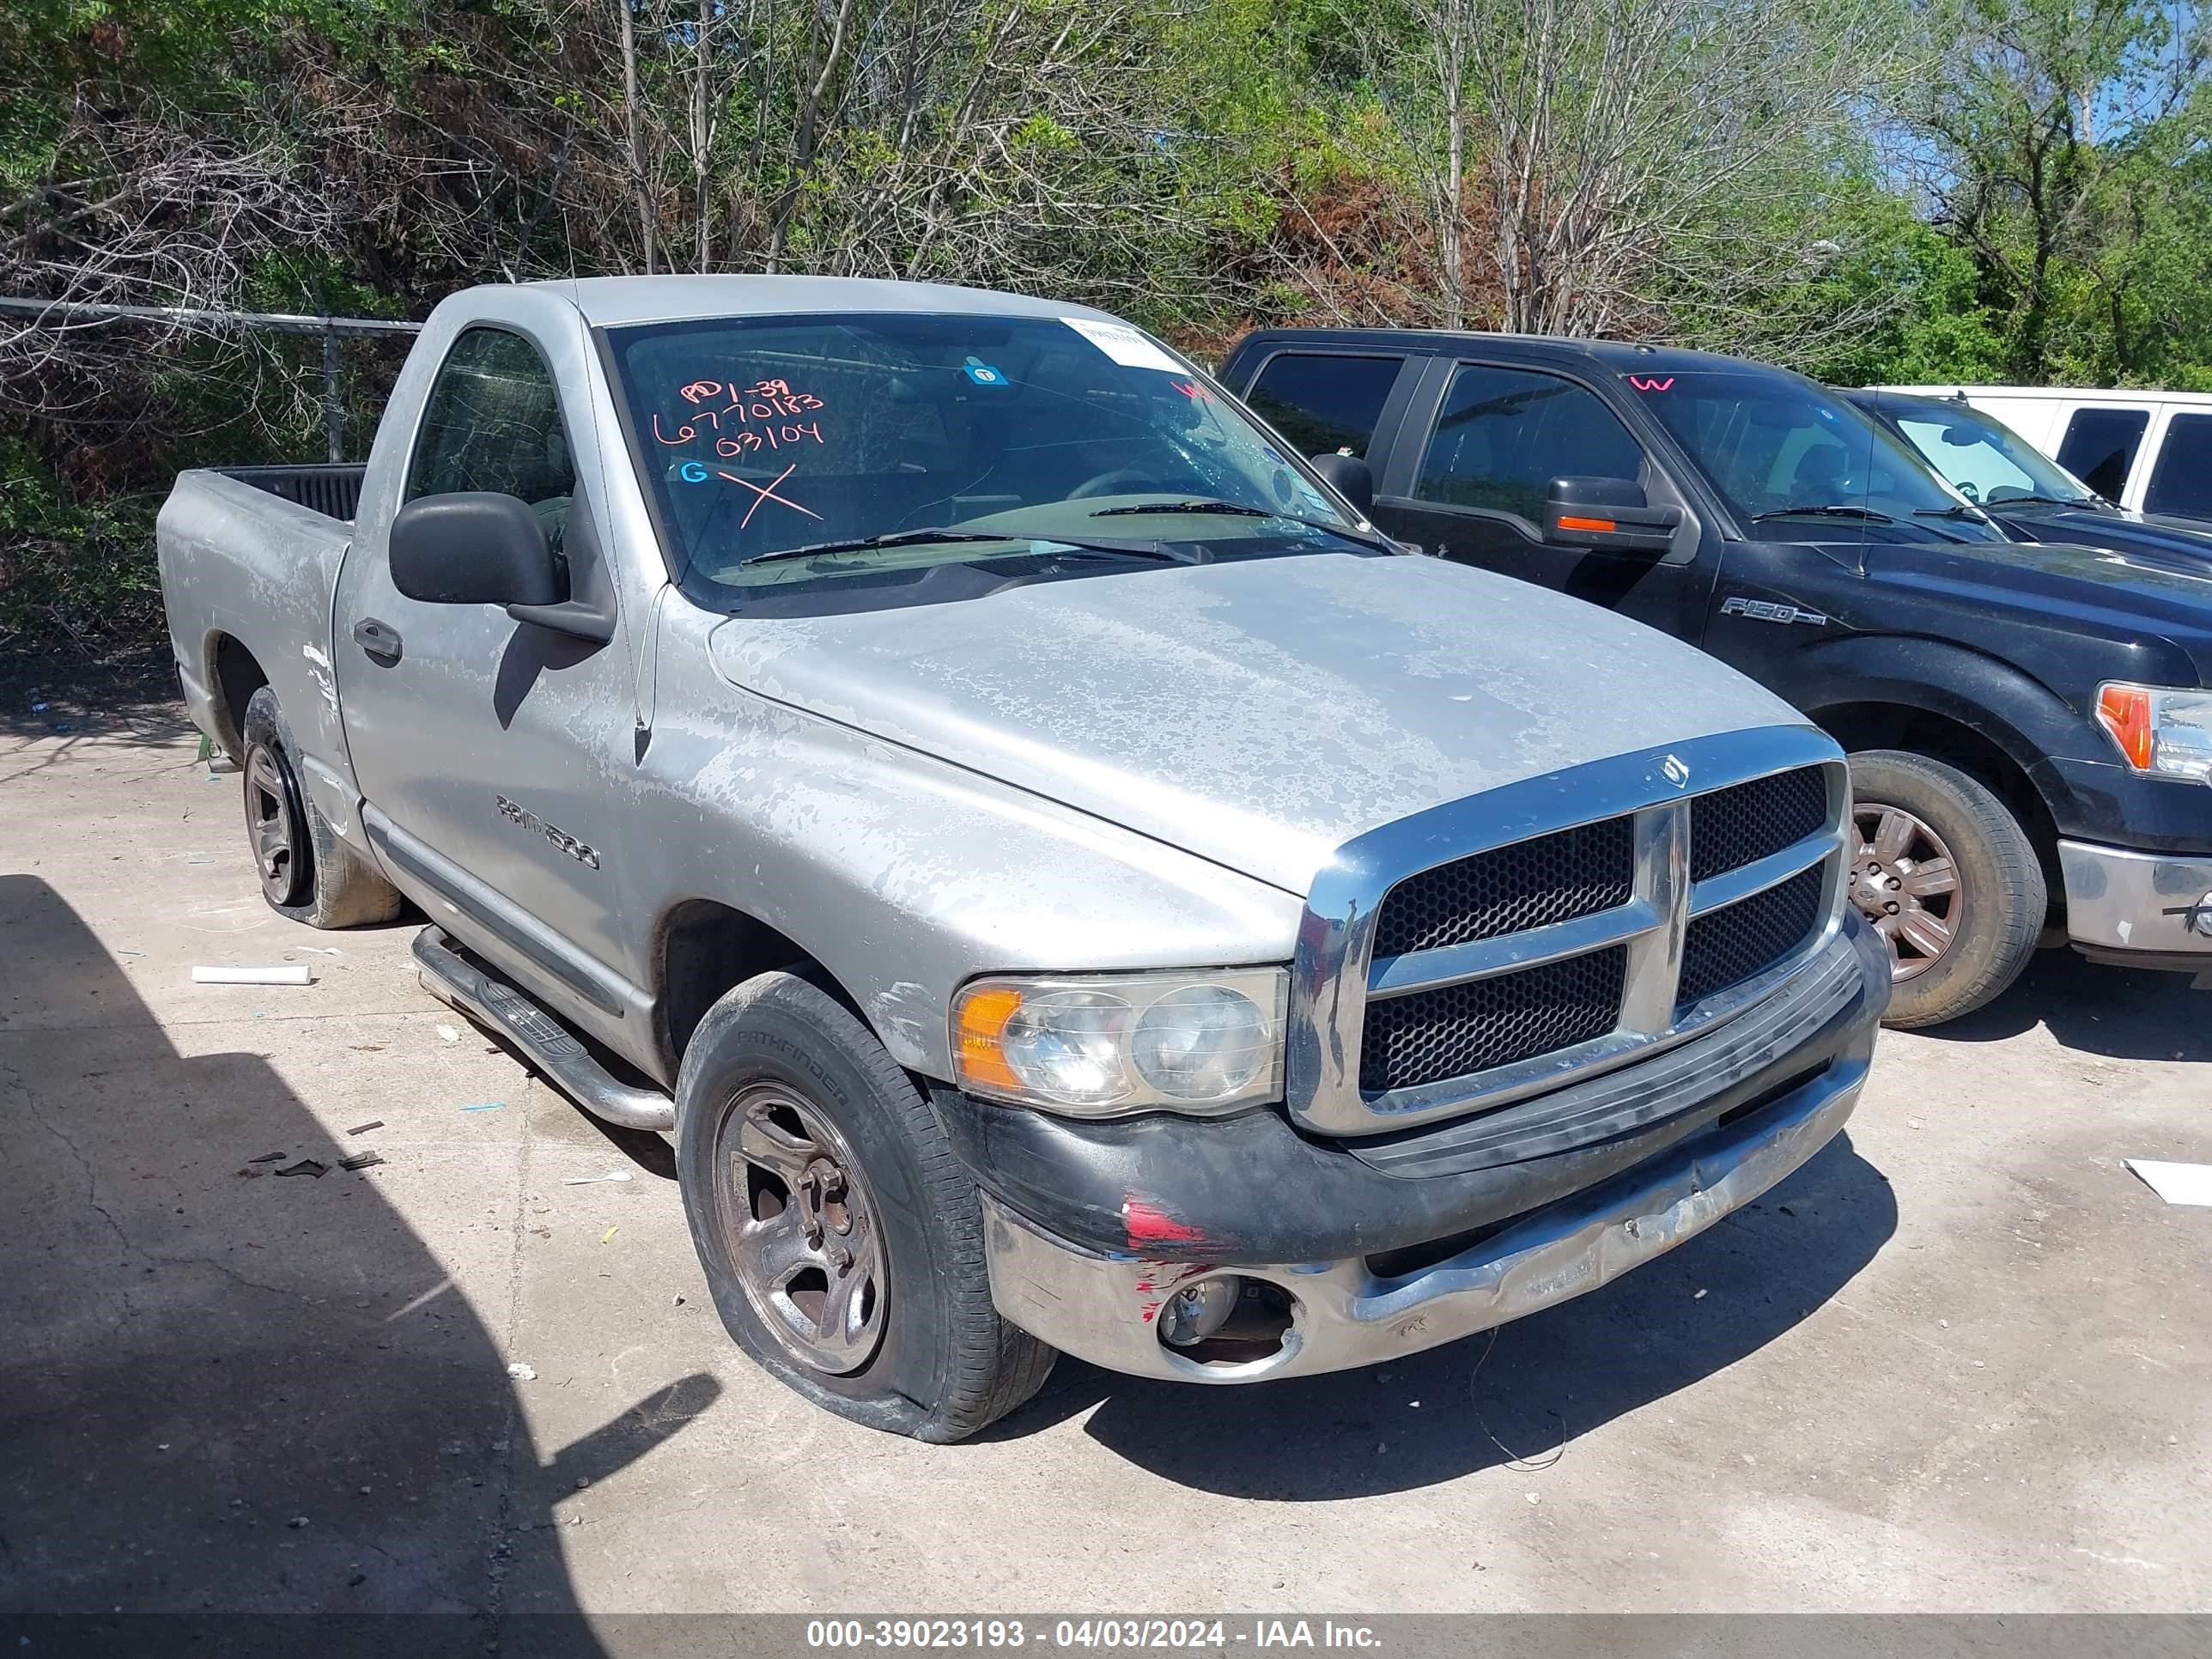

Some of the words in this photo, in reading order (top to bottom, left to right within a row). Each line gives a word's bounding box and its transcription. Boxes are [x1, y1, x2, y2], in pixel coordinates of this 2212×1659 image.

[1630, 375, 1674, 391] W
[680, 462, 708, 483] G
[738, 1030, 849, 1107] PATHFINDER
